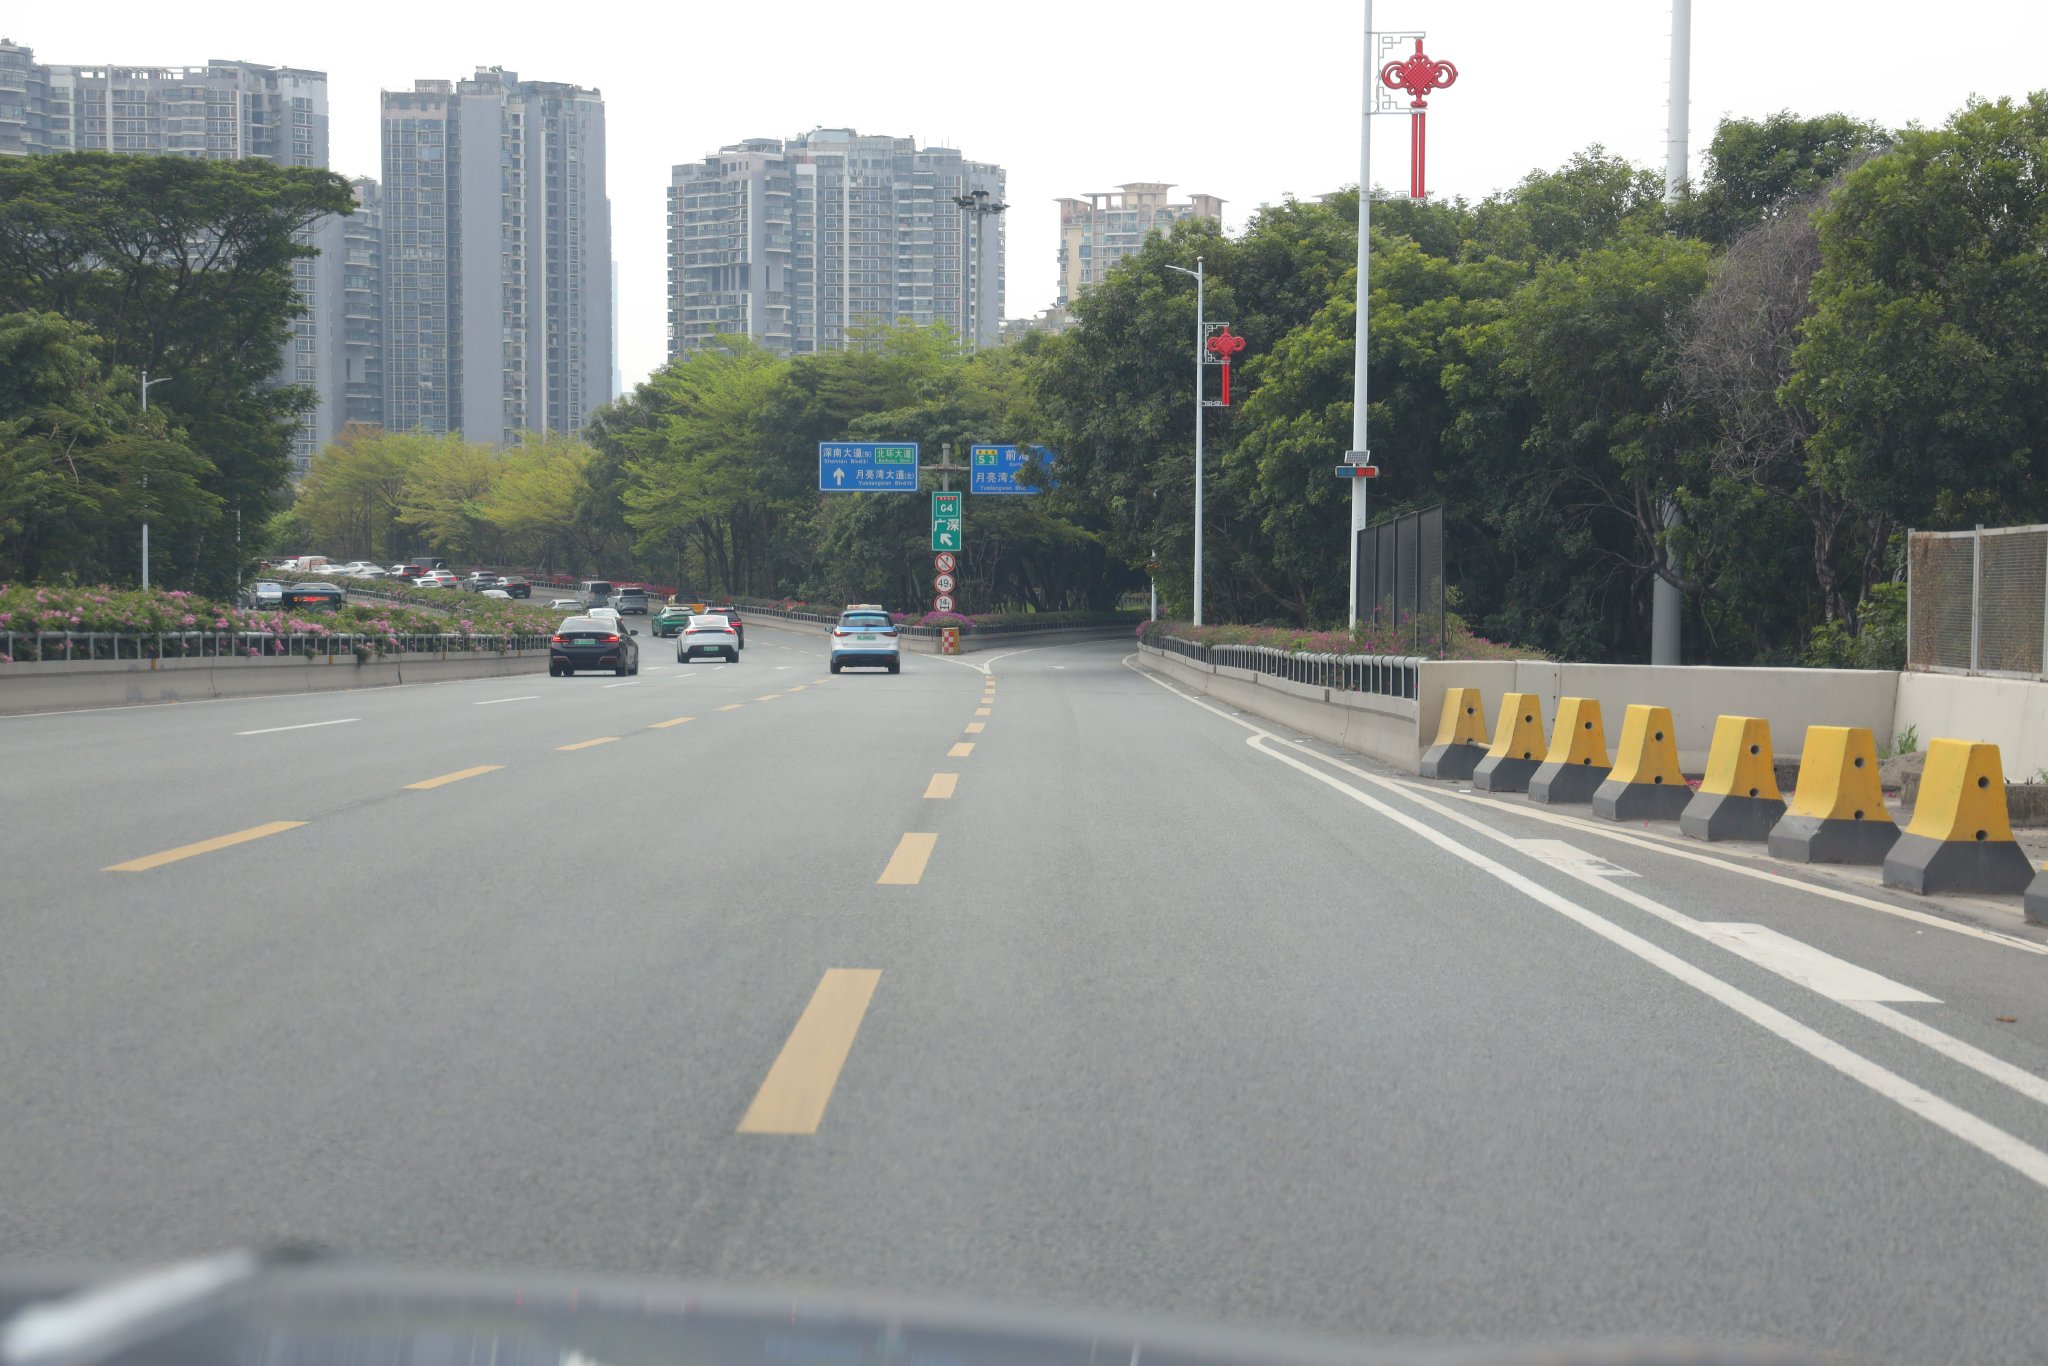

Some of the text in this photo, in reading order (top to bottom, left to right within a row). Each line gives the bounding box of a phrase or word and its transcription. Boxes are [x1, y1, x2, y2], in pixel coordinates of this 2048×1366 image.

[877, 449, 911, 459] 北环大道
[941, 504, 953, 512] G4
[934, 518, 960, 532] 广深
